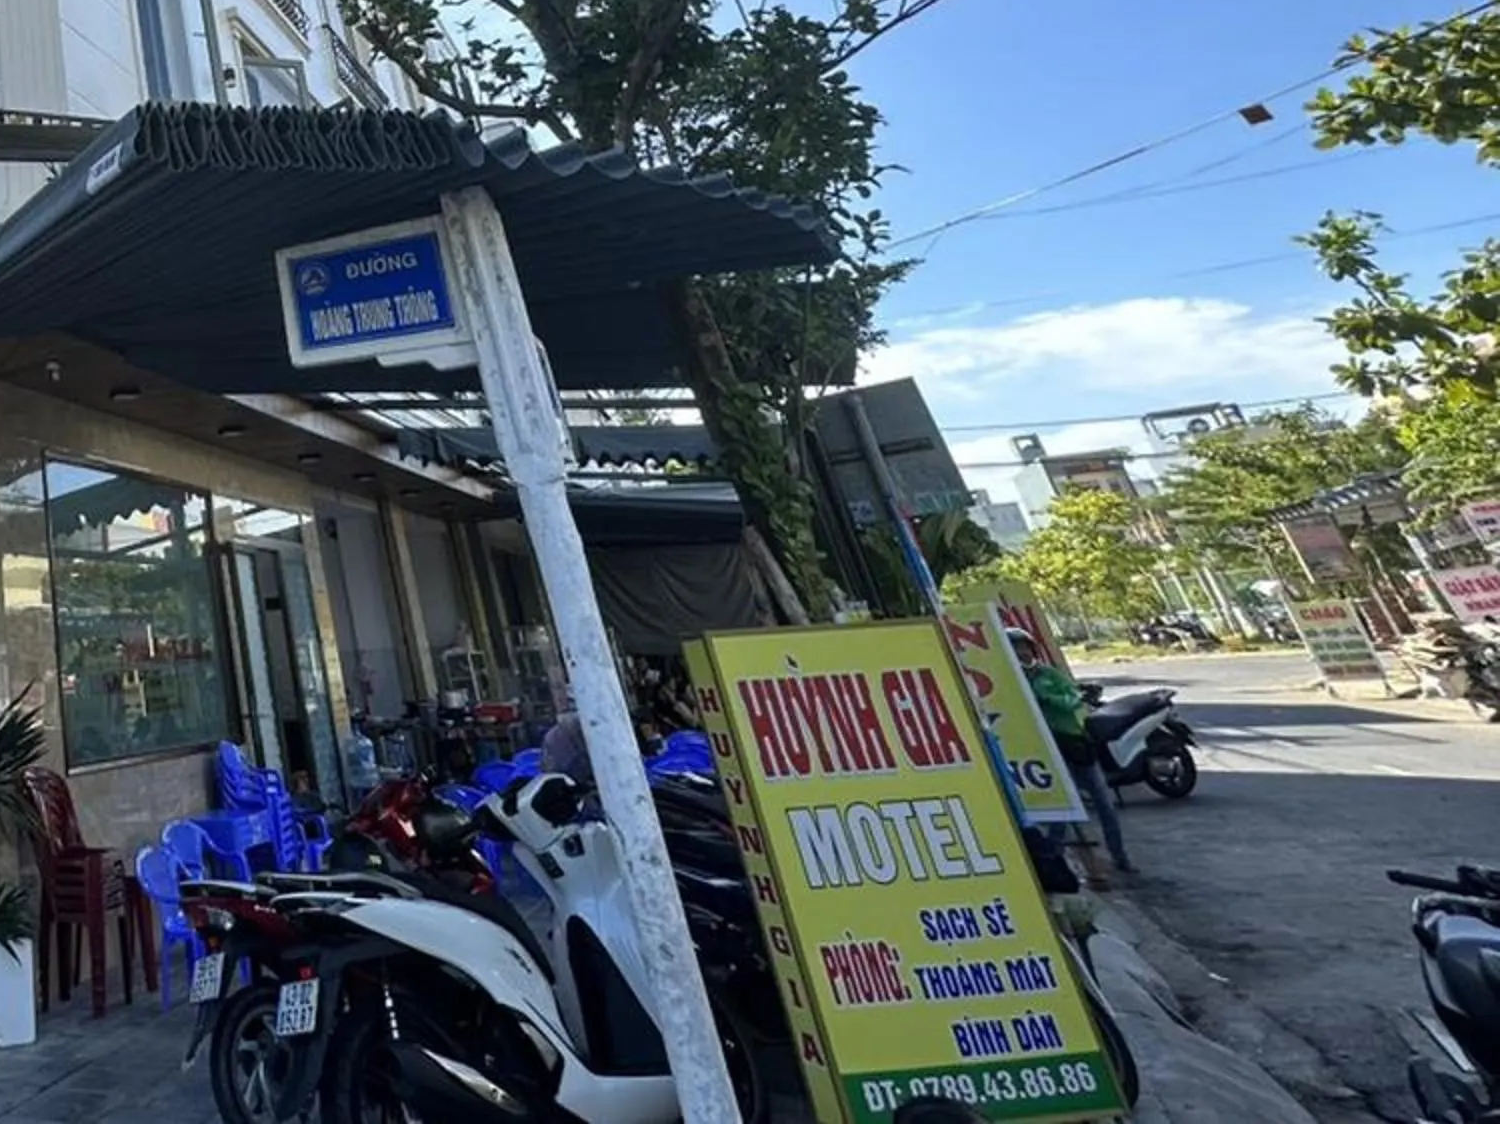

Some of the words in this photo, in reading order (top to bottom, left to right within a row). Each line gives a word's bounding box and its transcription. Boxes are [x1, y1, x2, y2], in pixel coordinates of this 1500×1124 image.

[352, 297, 396, 333] TRUNG
[737, 655, 898, 778] HUỲNH
[881, 667, 972, 767] GIA
[784, 794, 1004, 890] MOTEL
[919, 907, 981, 947] SẠCH
[820, 931, 913, 1005] PHÒNG:
[913, 957, 1005, 1000] THOÁNG
[1004, 950, 1057, 991] MÁT
[951, 1015, 1012, 1058] BÌNH
[1012, 1009, 1063, 1051] DÂN
[909, 1062, 1097, 1103] 0789.43.86.86
